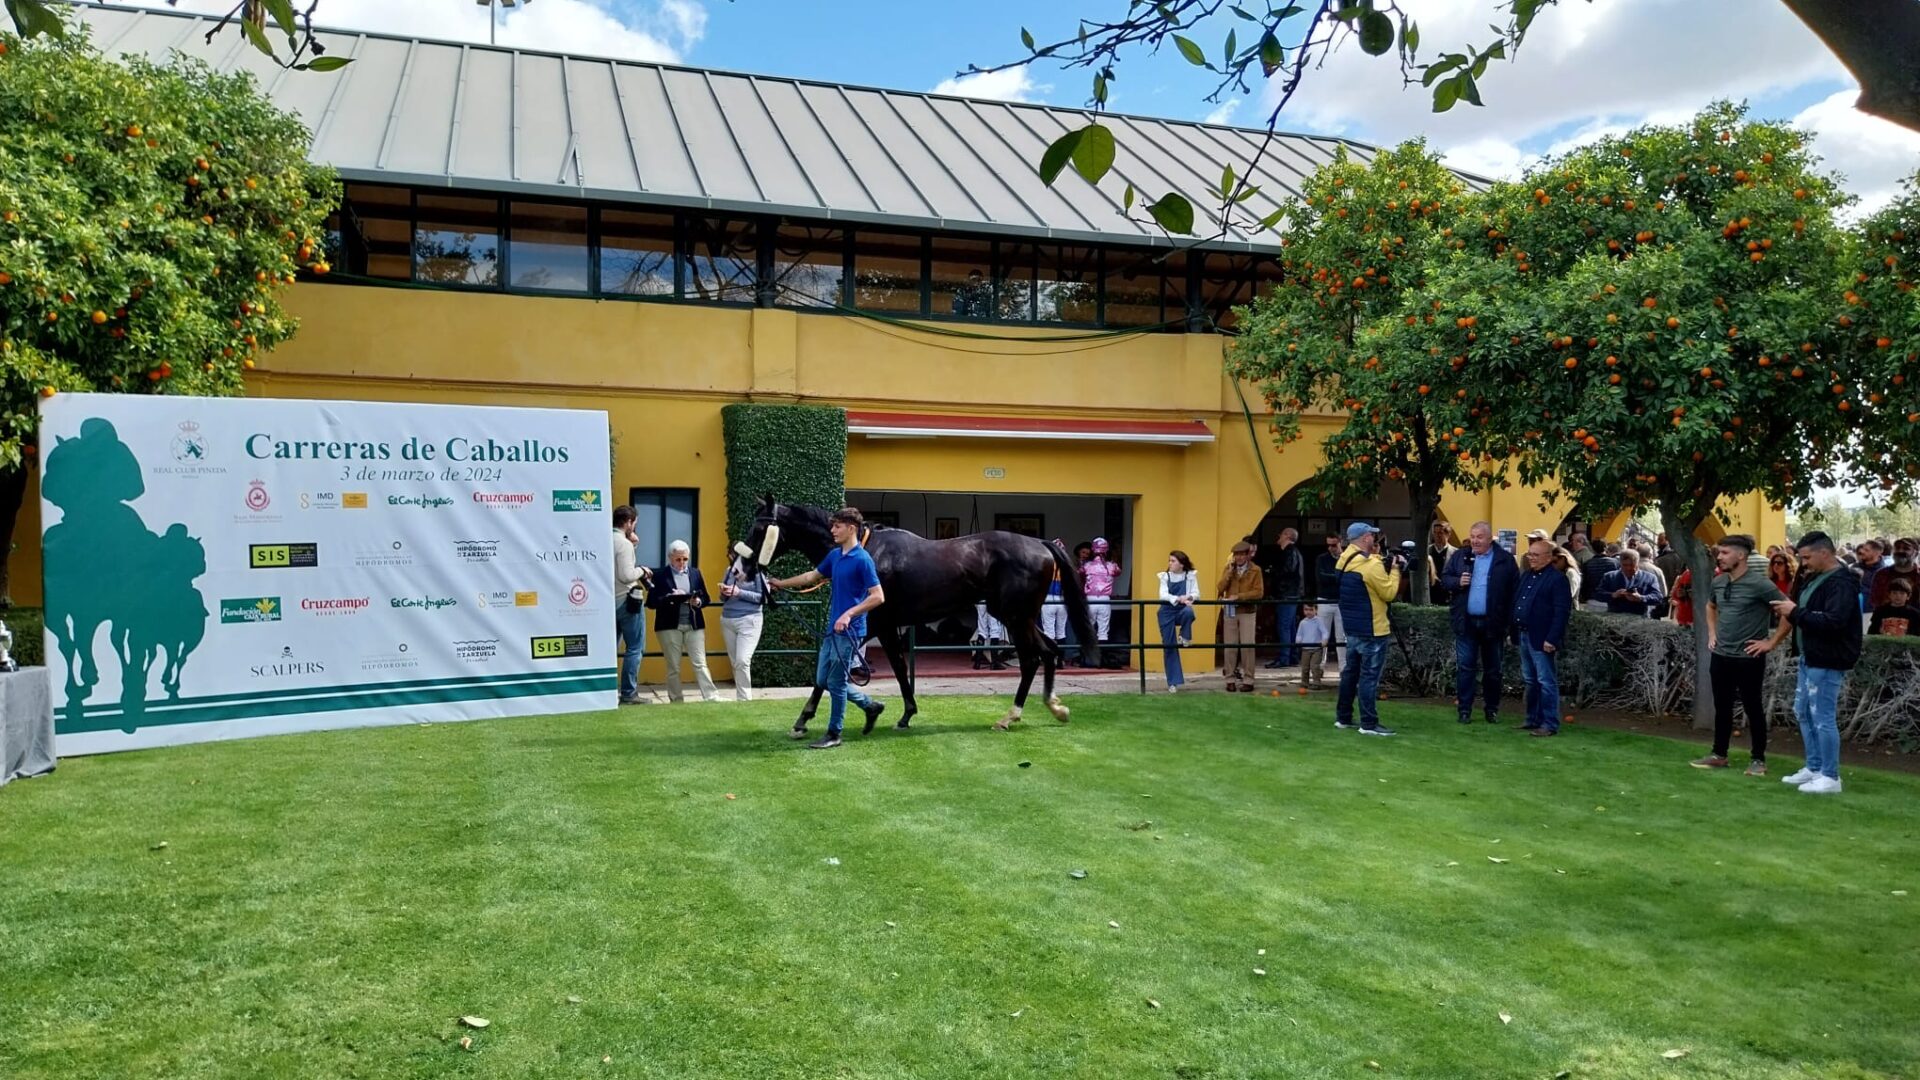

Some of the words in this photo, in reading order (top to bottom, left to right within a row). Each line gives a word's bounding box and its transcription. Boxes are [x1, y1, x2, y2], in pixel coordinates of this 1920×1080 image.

[245, 433, 391, 461] Carreras
[401, 437, 436, 461] de
[445, 437, 569, 463] Caballos
[340, 465, 350, 481] 3
[356, 465, 377, 481] de
[382, 469, 435, 482] marzo
[440, 467, 460, 482] de
[464, 467, 502, 482] 2024
[317, 492, 334, 500] IMD
[473, 491, 534, 504] Cruzcampo
[257, 550, 285, 562] SIS
[535, 550, 597, 562] SCALPERS
[301, 598, 369, 610] Cruzcampo
[538, 641, 561, 653] SIS
[250, 661, 325, 677] SCALPERS
